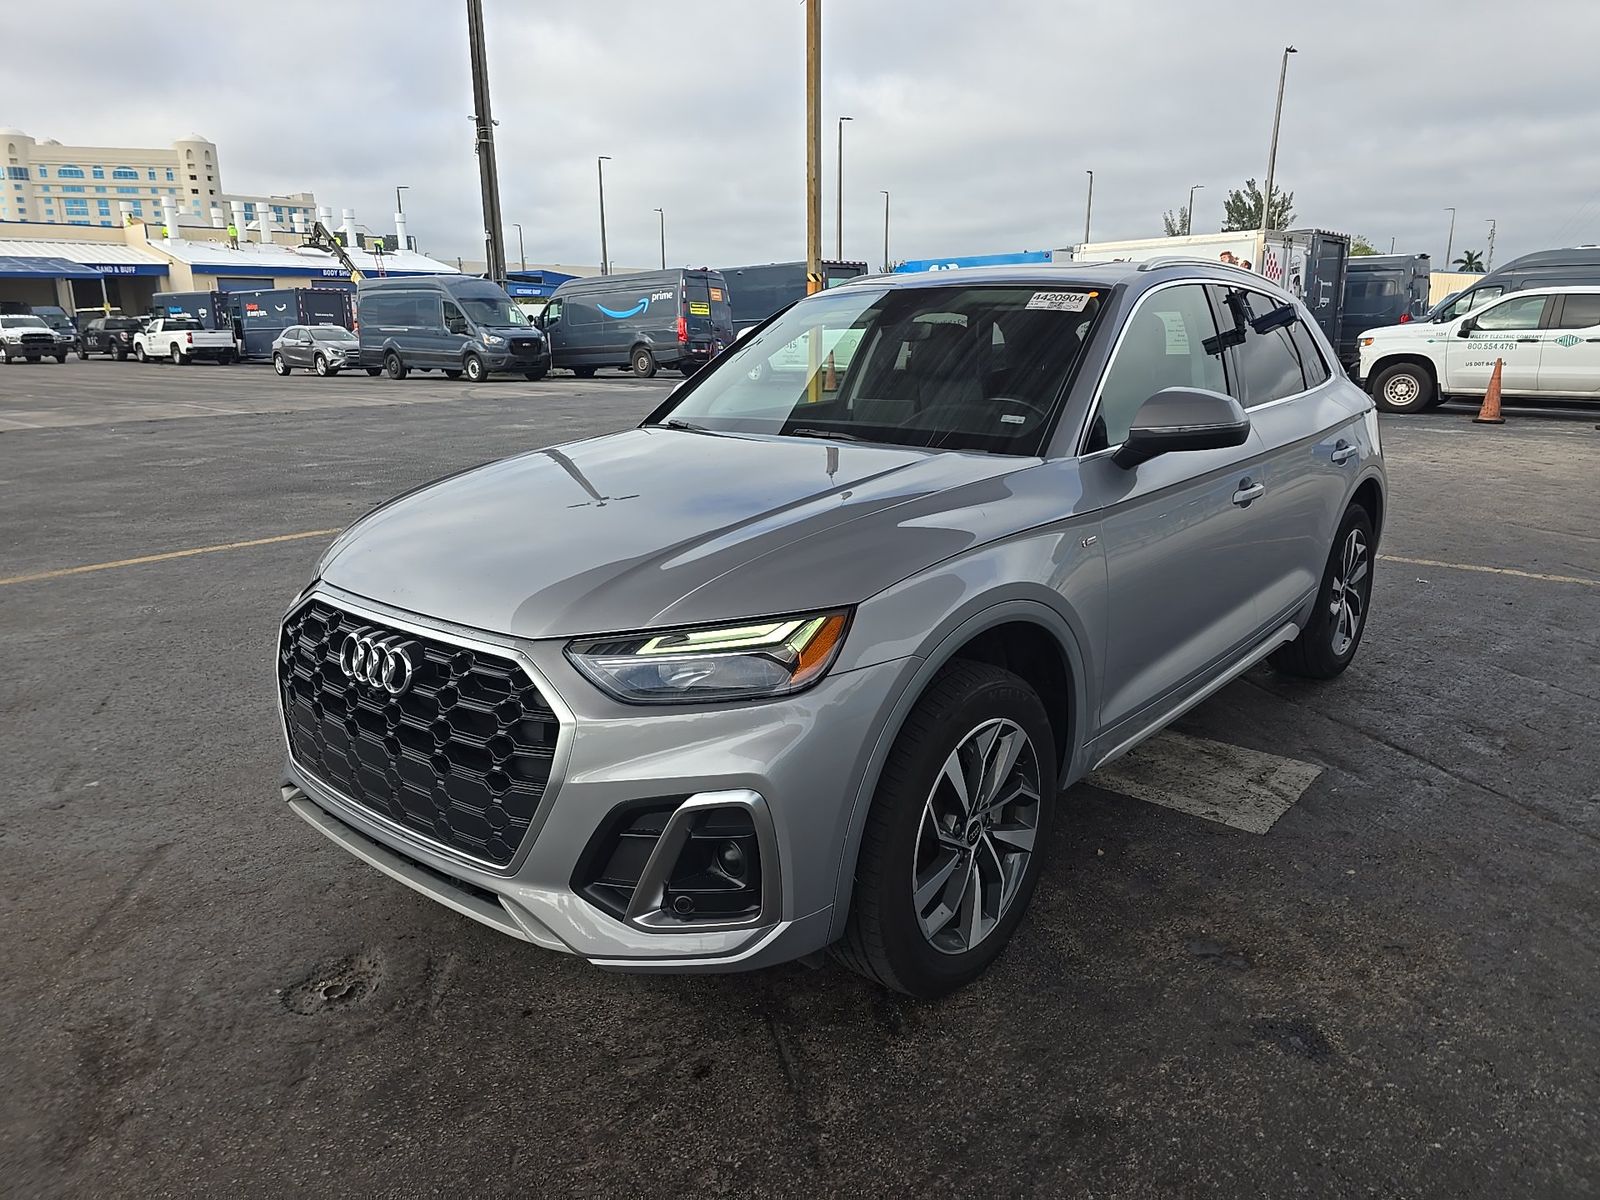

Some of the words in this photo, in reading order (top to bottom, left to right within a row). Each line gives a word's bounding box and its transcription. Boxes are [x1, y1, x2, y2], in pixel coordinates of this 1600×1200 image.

[96, 265, 113, 273] SAND
[120, 266, 136, 274] BUFF
[322, 269, 338, 277] BODY
[651, 290, 673, 303] prime
[1033, 293, 1085, 302] 4420904
[1467, 343, 1518, 351] 800.554.4761
[988, 687, 1029, 702] KELLY
